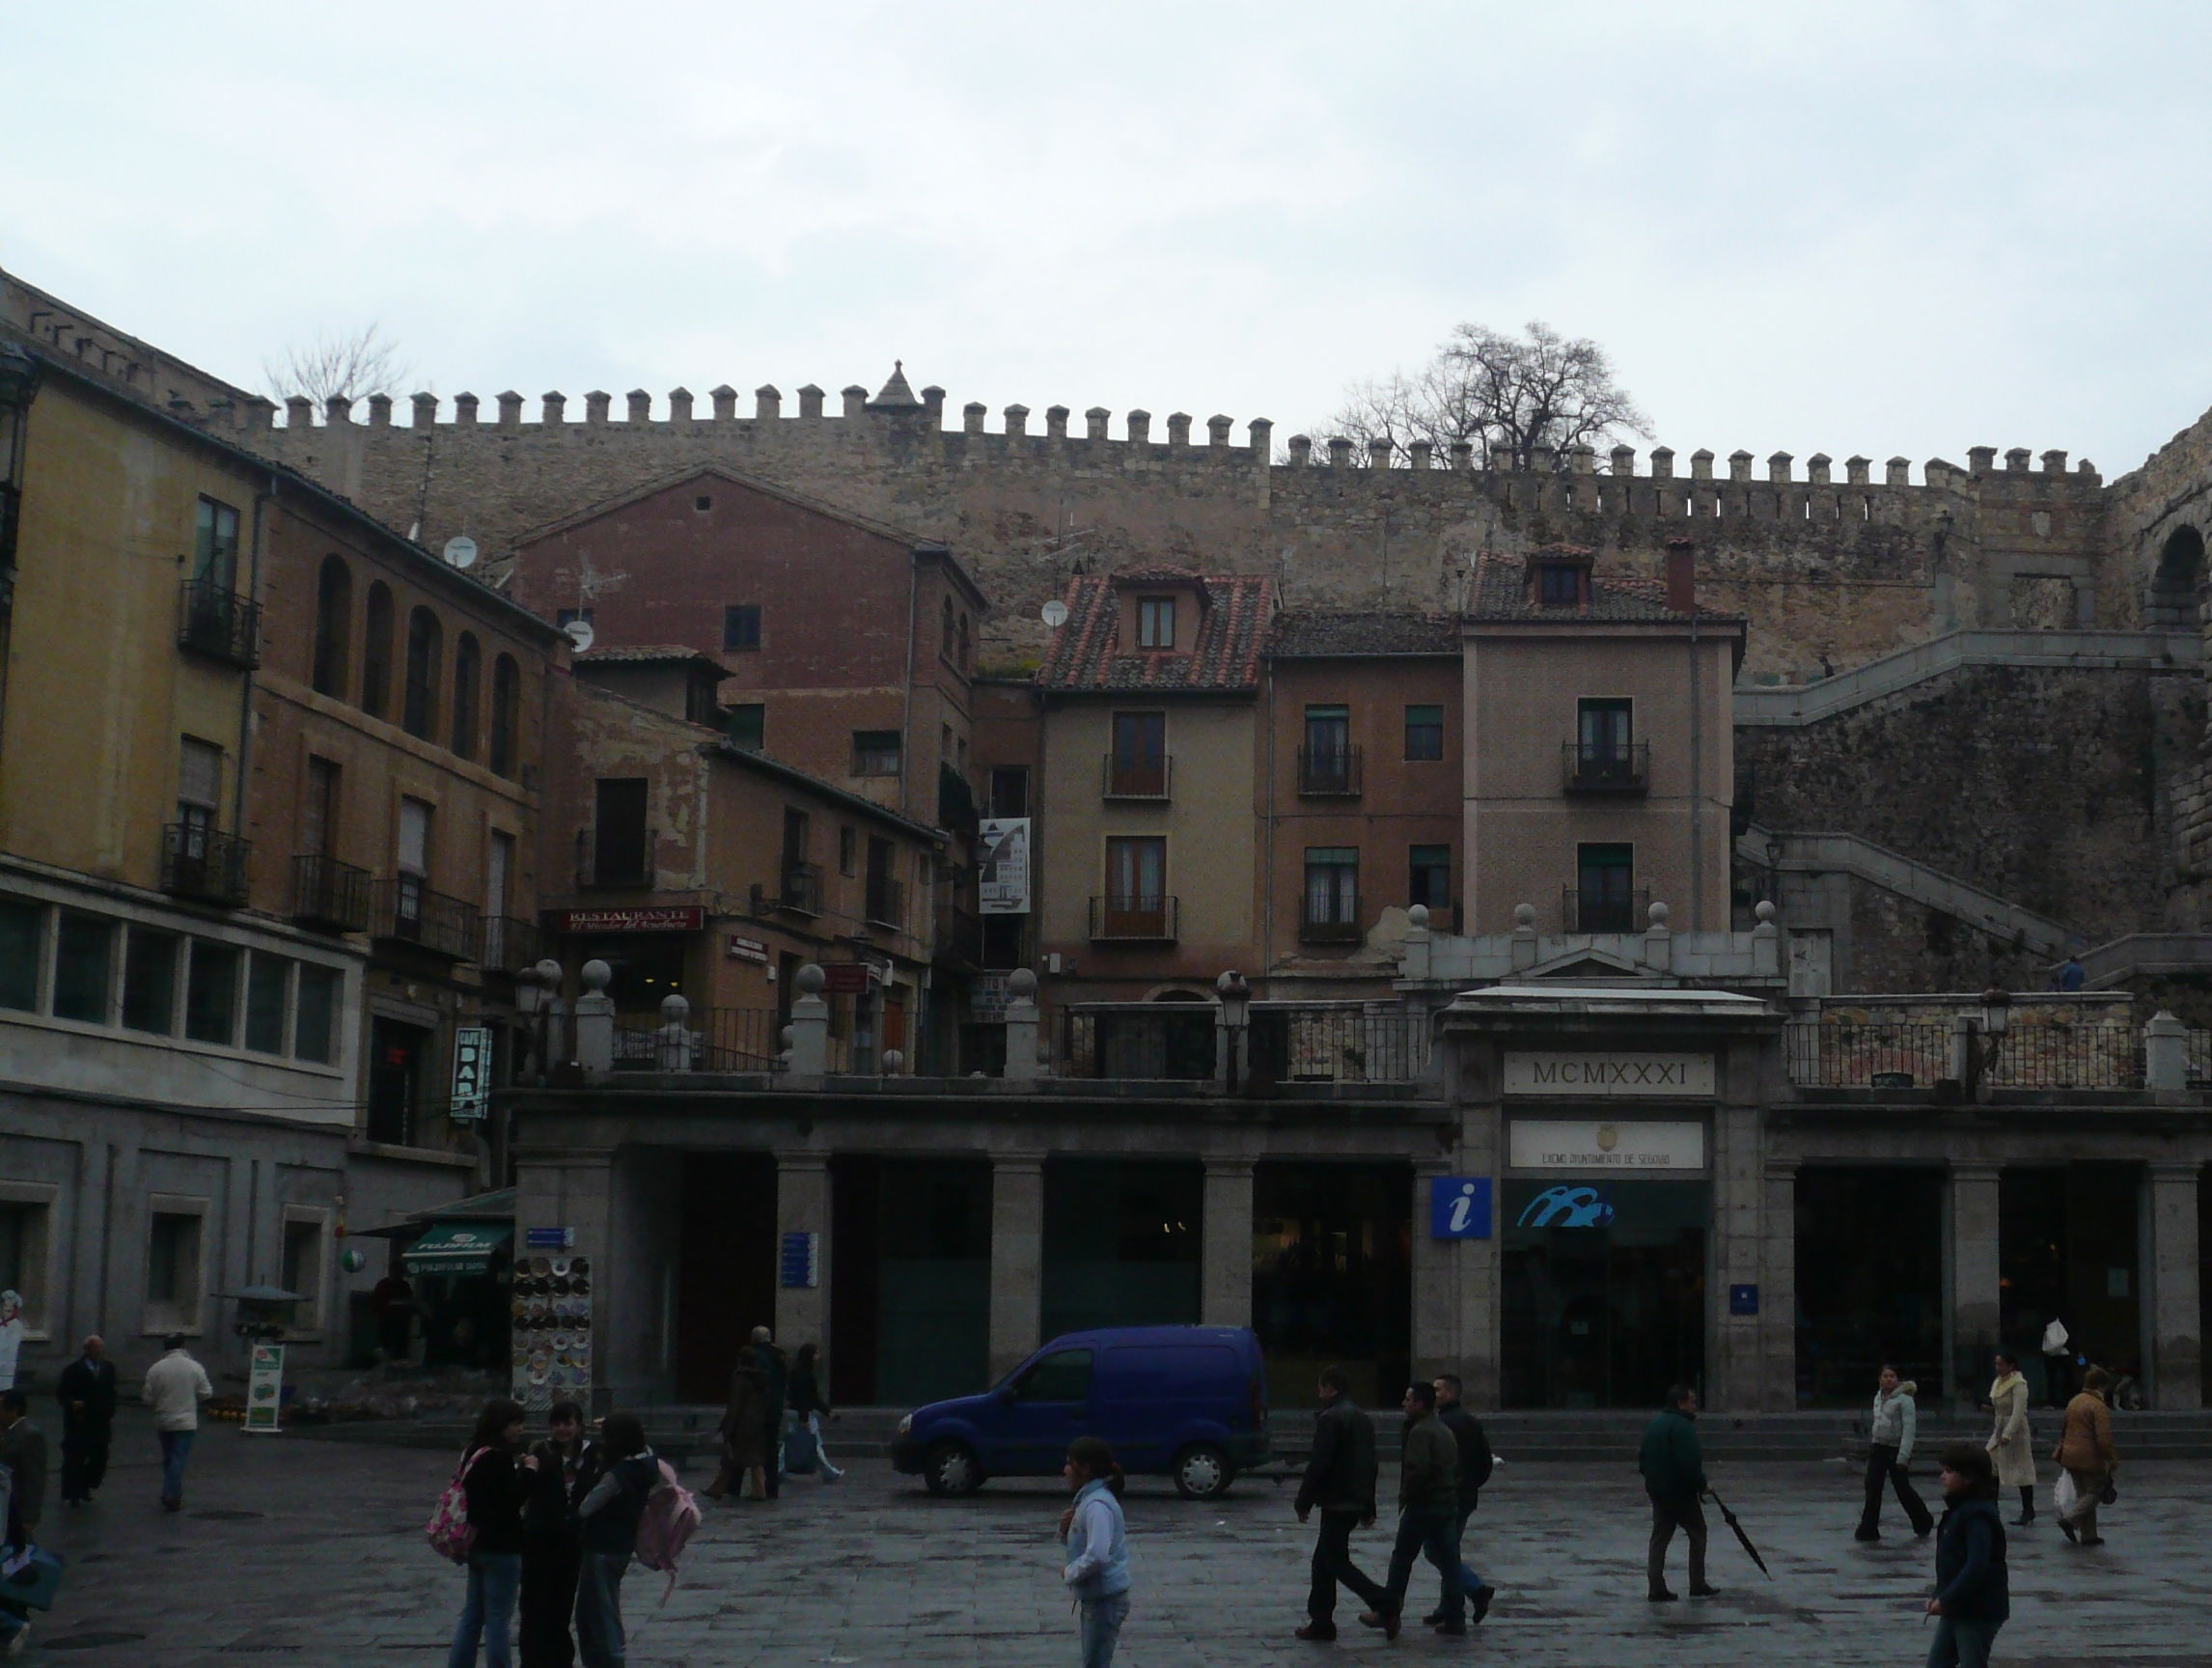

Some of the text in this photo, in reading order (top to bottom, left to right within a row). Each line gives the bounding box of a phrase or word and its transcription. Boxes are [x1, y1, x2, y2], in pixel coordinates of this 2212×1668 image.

[569, 910, 690, 922] RESTAURANTE
[457, 1047, 476, 1097] BAR
[1533, 1062, 1686, 1084] MCMXXXI
[1569, 1154, 1621, 1164] AYUNTAMIENTO
[1624, 1154, 1635, 1164] DE
[1638, 1154, 1671, 1165] SEGOVIA
[417, 1241, 492, 1250] FUJIFILM
[421, 1263, 463, 1271] FUJIFILM
